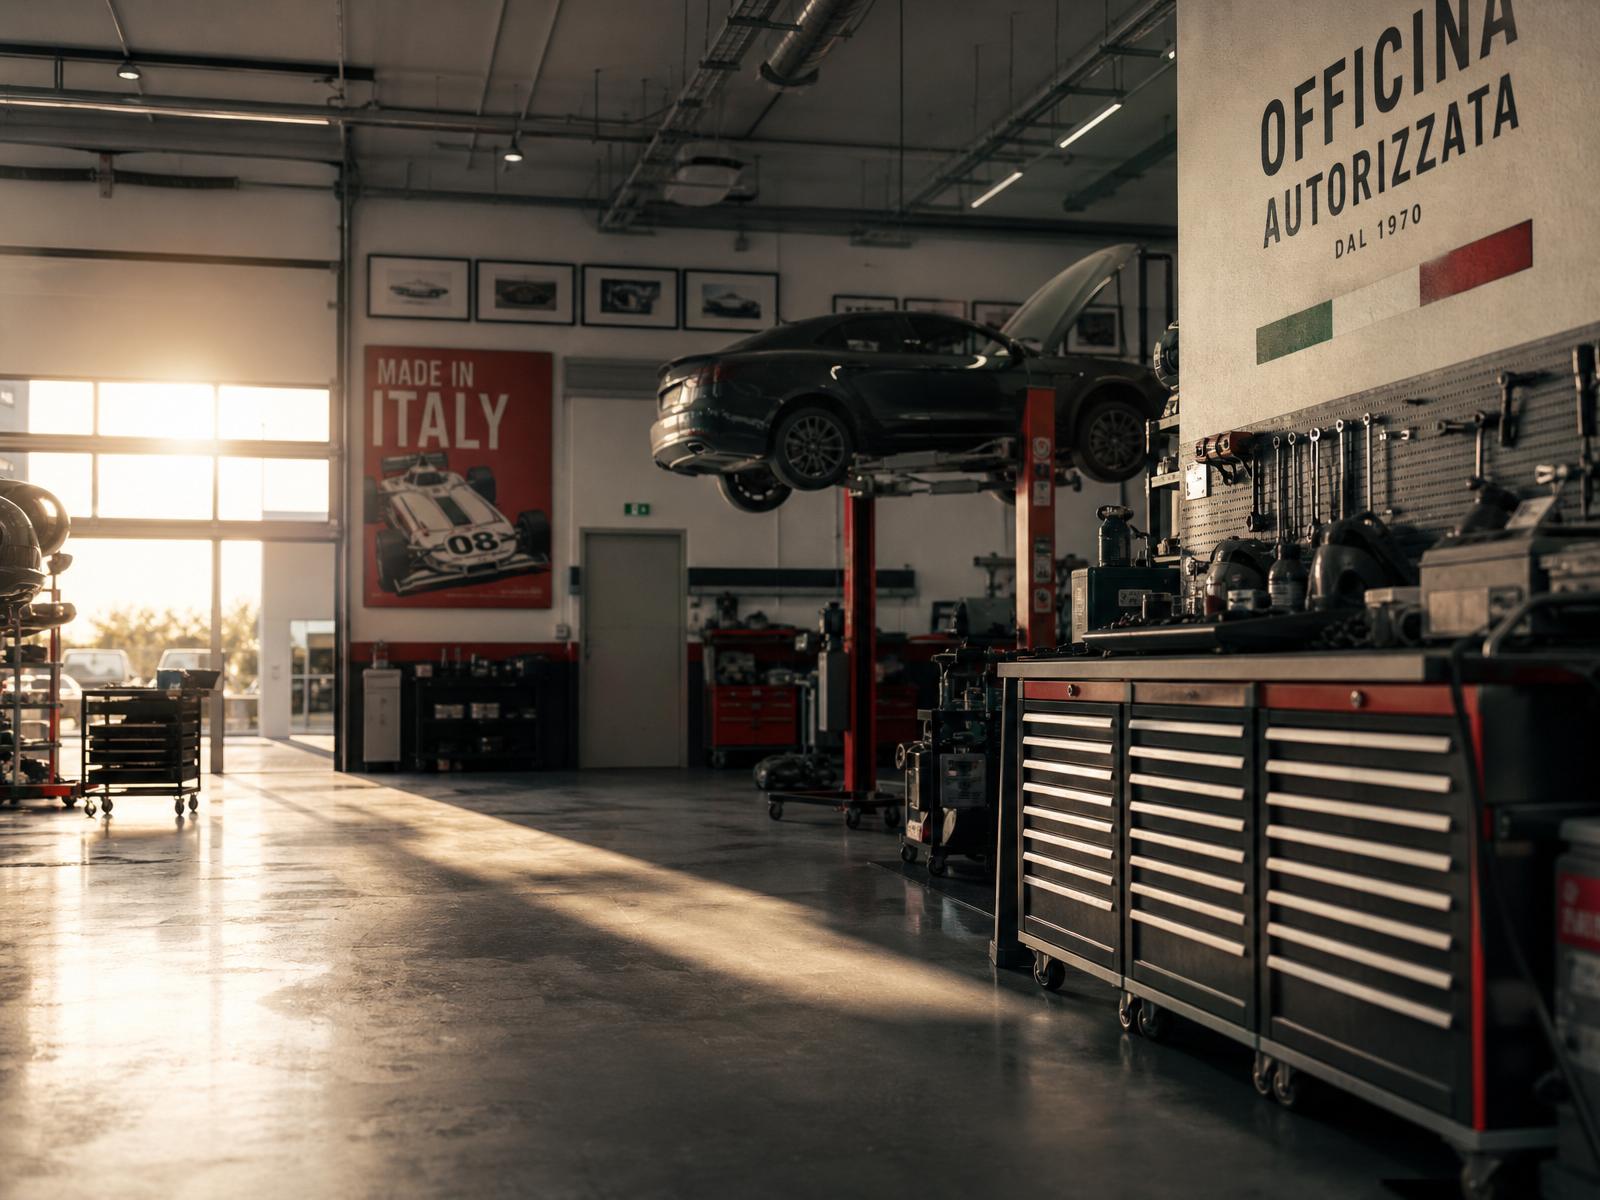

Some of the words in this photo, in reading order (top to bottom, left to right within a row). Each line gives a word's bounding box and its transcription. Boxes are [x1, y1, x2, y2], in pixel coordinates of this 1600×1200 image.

[1260, 0, 1518, 176] OFFICINA
[1263, 72, 1520, 249] AUTORIZZATA
[1335, 228, 1367, 259] DAL
[1377, 203, 1422, 239] 1970
[377, 358, 442, 387] MADE
[451, 361, 475, 388] IN
[372, 389, 509, 450] ITALY
[447, 531, 499, 555] 08
